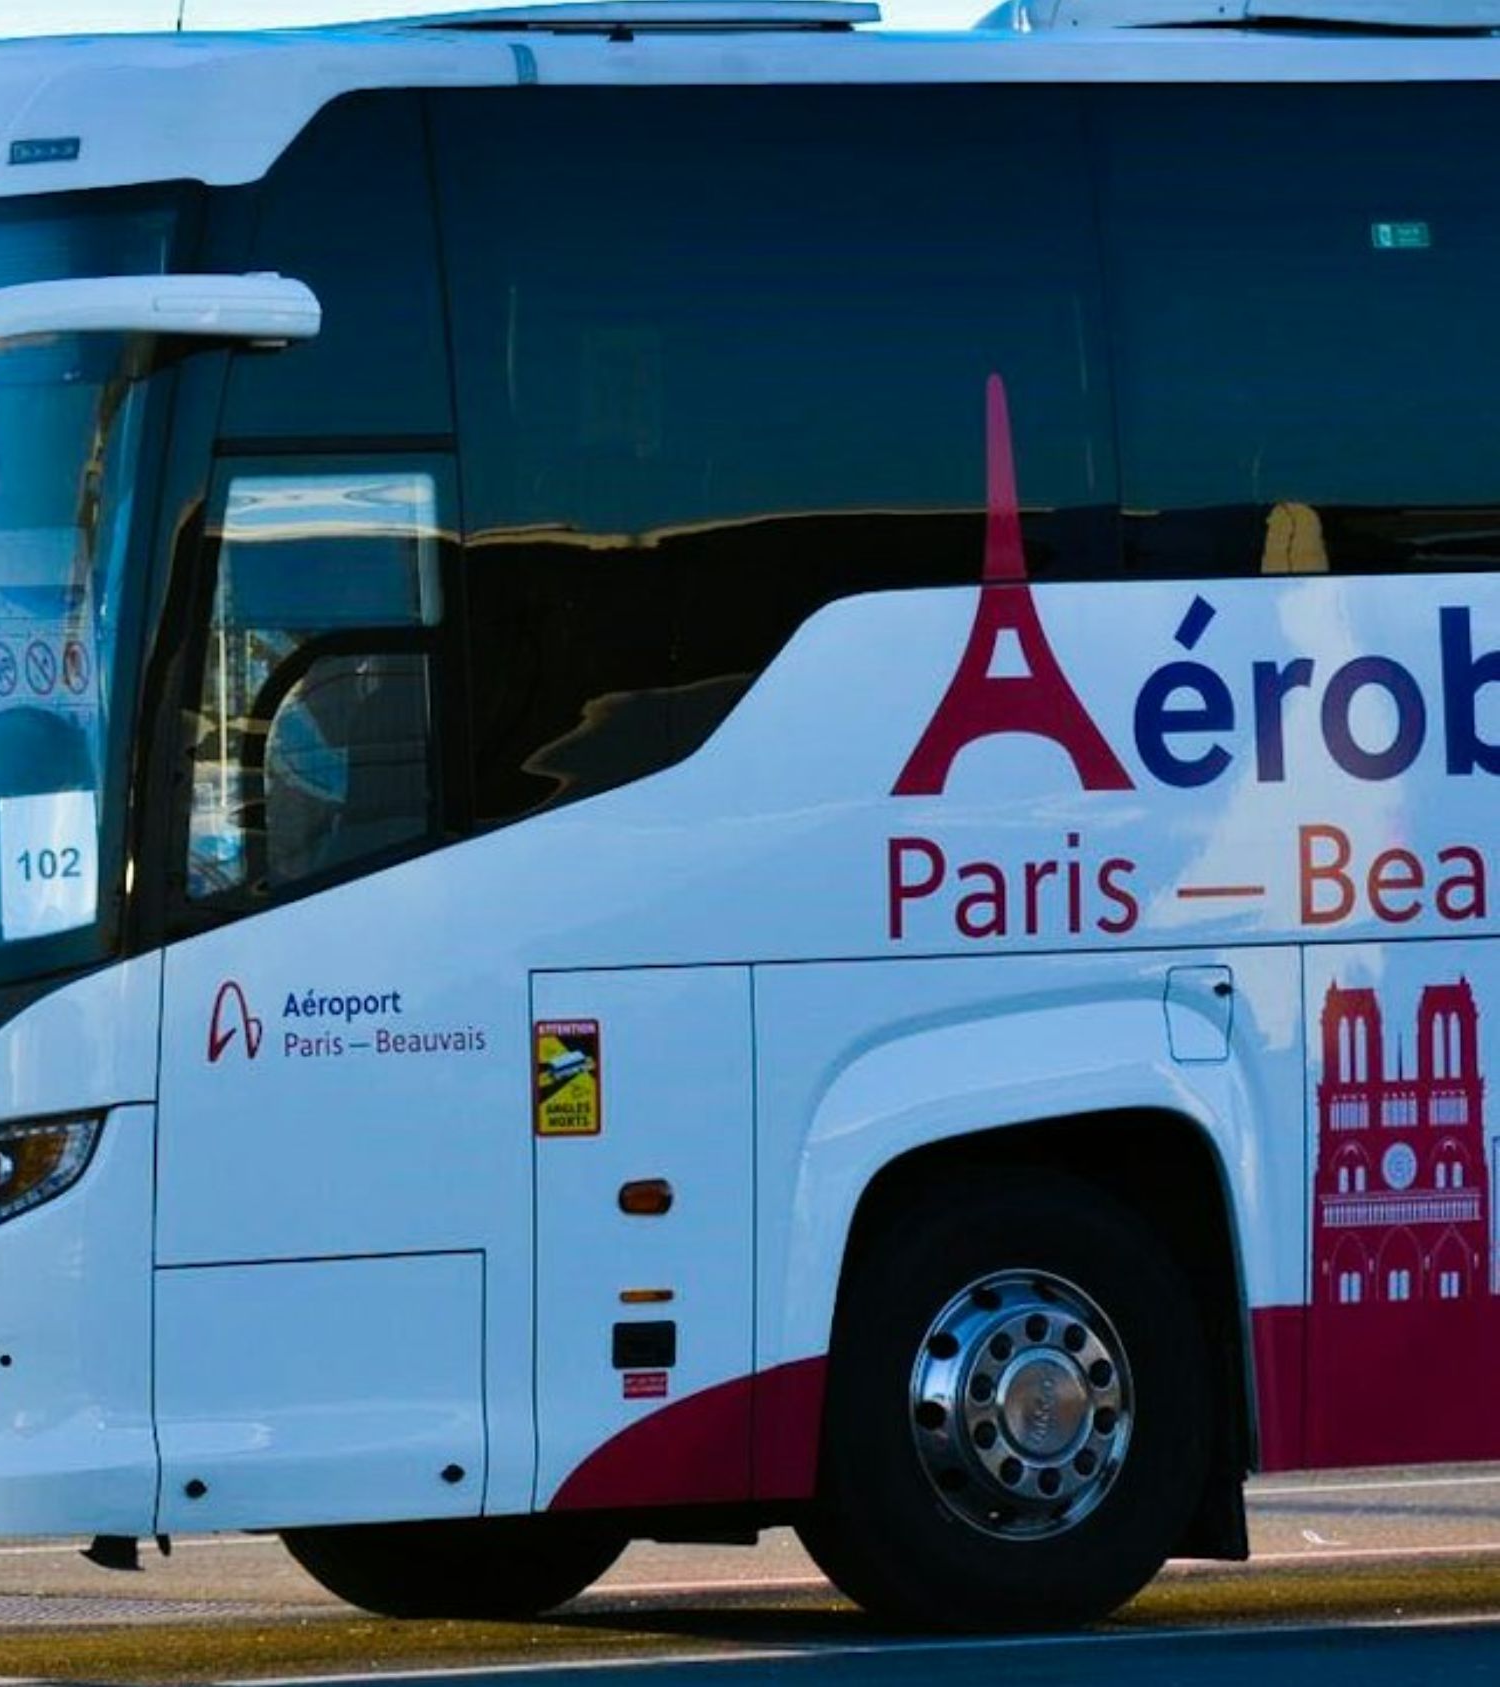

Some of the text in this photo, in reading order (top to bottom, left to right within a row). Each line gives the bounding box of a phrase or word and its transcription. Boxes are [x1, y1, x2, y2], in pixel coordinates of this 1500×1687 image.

[17, 847, 82, 881] 102
[888, 832, 1138, 940] Paris
[1299, 824, 1486, 925] Bea
[282, 989, 402, 1022] Aéroport
[284, 1031, 343, 1057] Paris
[376, 1026, 486, 1053] Beauvais
